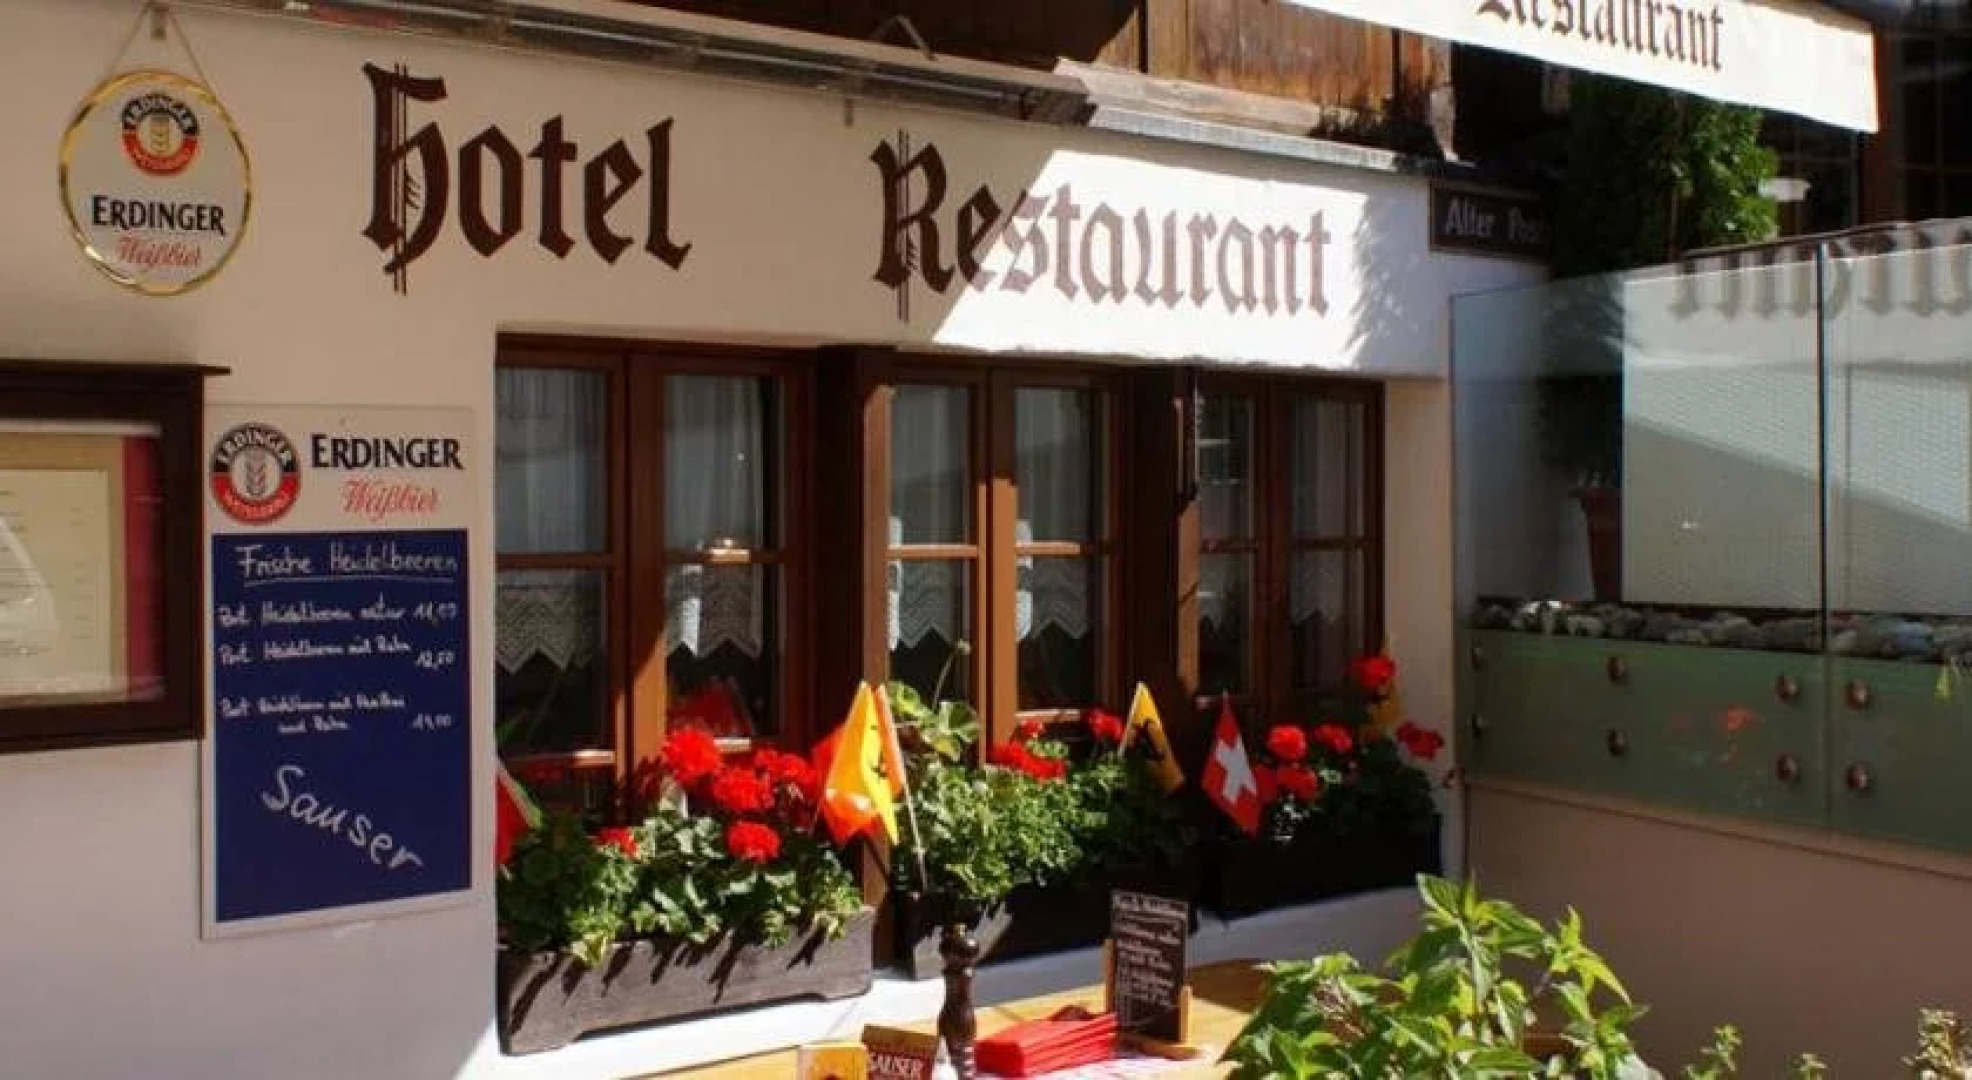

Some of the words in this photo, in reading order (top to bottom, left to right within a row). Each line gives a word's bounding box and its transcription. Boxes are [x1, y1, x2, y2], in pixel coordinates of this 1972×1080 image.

[92, 194, 226, 236] ERDINGER
[869, 130, 1331, 322] Restaurant
[311, 434, 465, 470] ERDINGER
[236, 544, 312, 578] Frische
[330, 540, 459, 574] Heidelbeeren
[262, 764, 425, 870] Sauser
